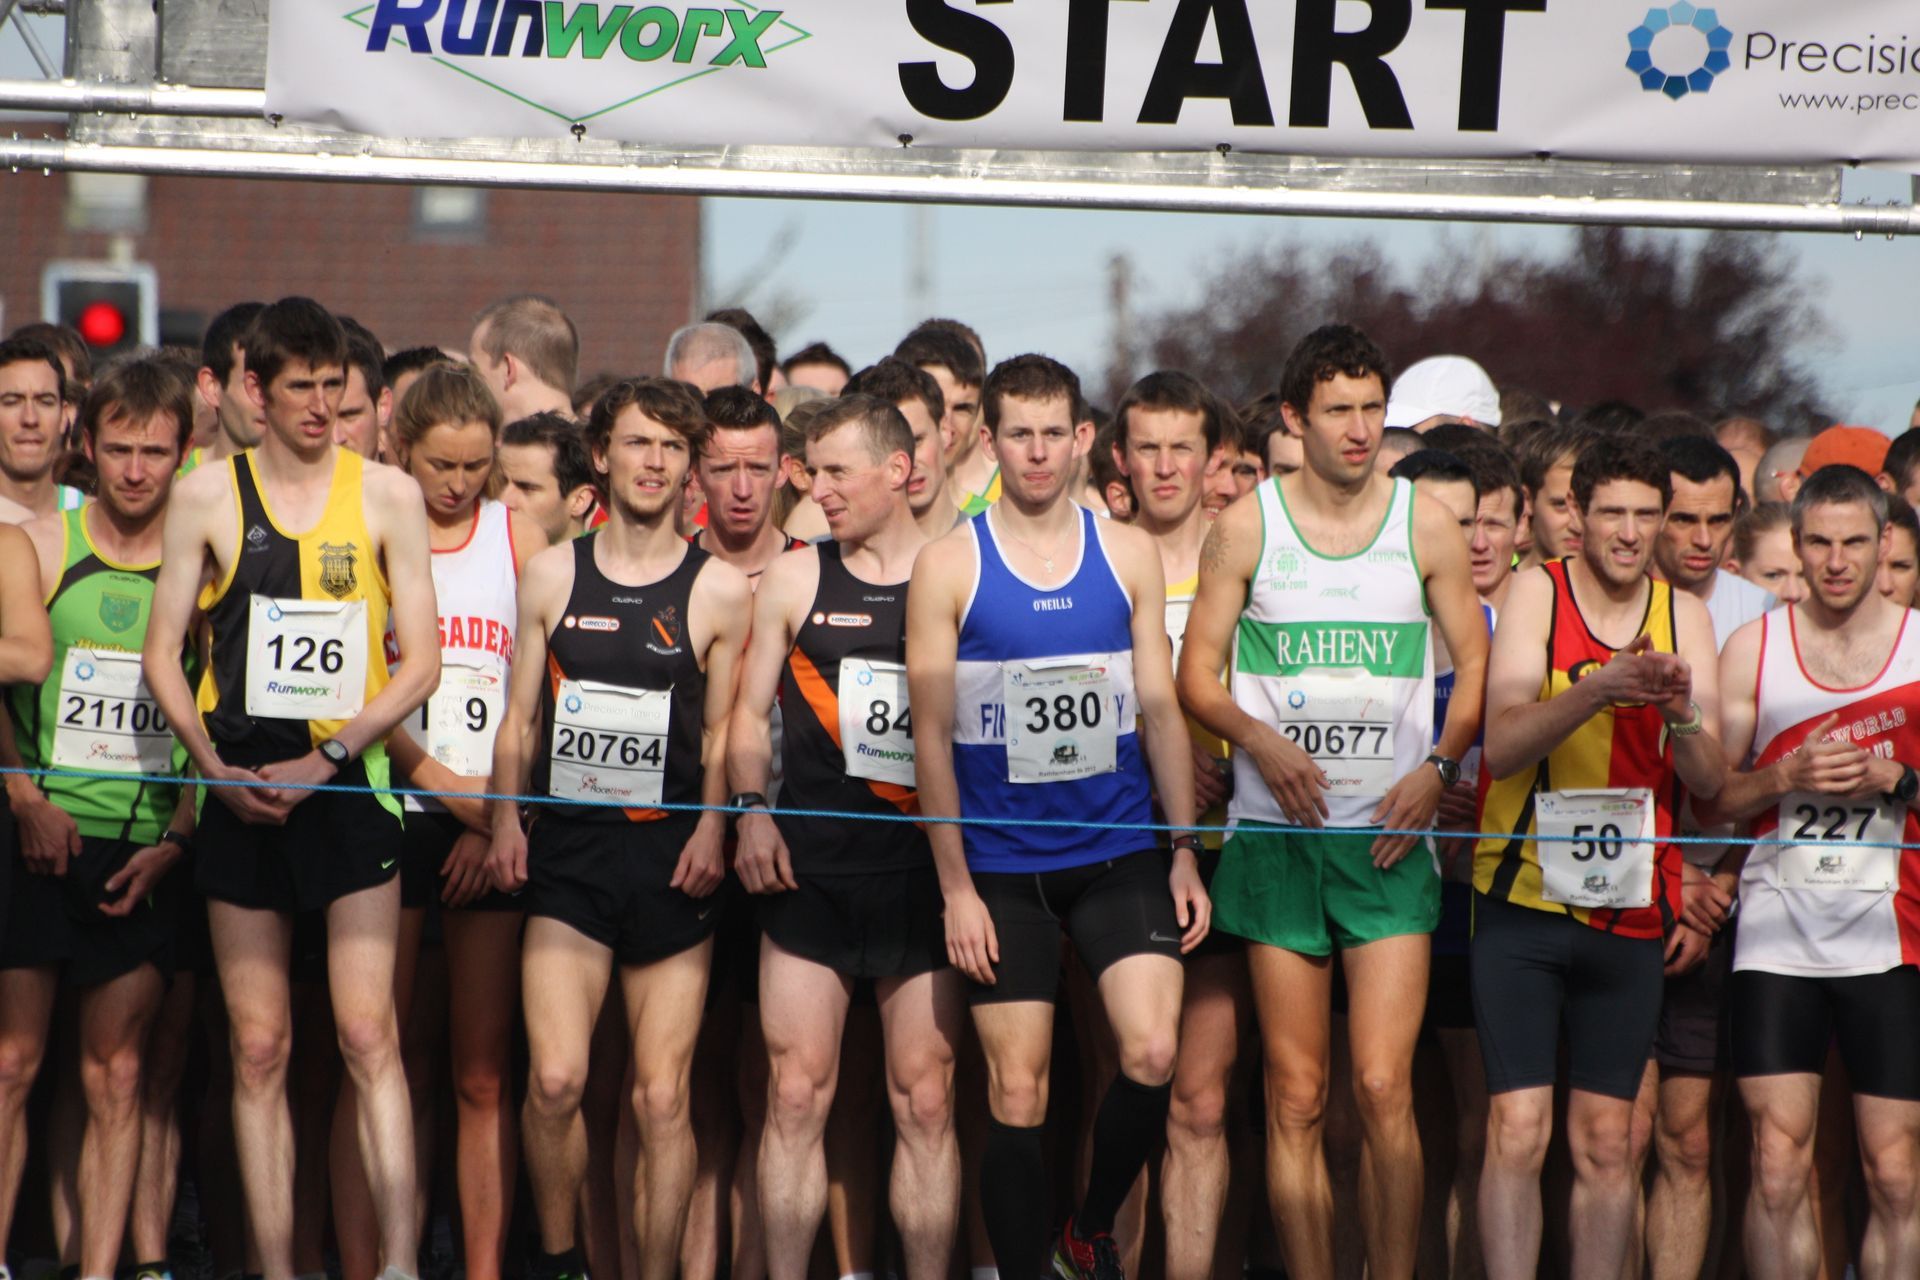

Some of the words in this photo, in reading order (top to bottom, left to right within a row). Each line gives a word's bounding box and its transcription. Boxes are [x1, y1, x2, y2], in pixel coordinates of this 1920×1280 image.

[366, 0, 783, 67] Runworx
[899, 0, 1547, 132] START
[1033, 597, 1073, 612] O'NEILLS
[266, 634, 344, 674] 126
[1276, 629, 1399, 665] RAHENY
[266, 681, 331, 697] Runworx
[64, 696, 168, 732] 21100
[1025, 691, 1101, 734] 380
[556, 728, 663, 767] 20764
[1283, 725, 1389, 755] 20677
[590, 783, 633, 797] Racetimer
[1793, 803, 1876, 841] 227
[1571, 823, 1623, 862] 50
